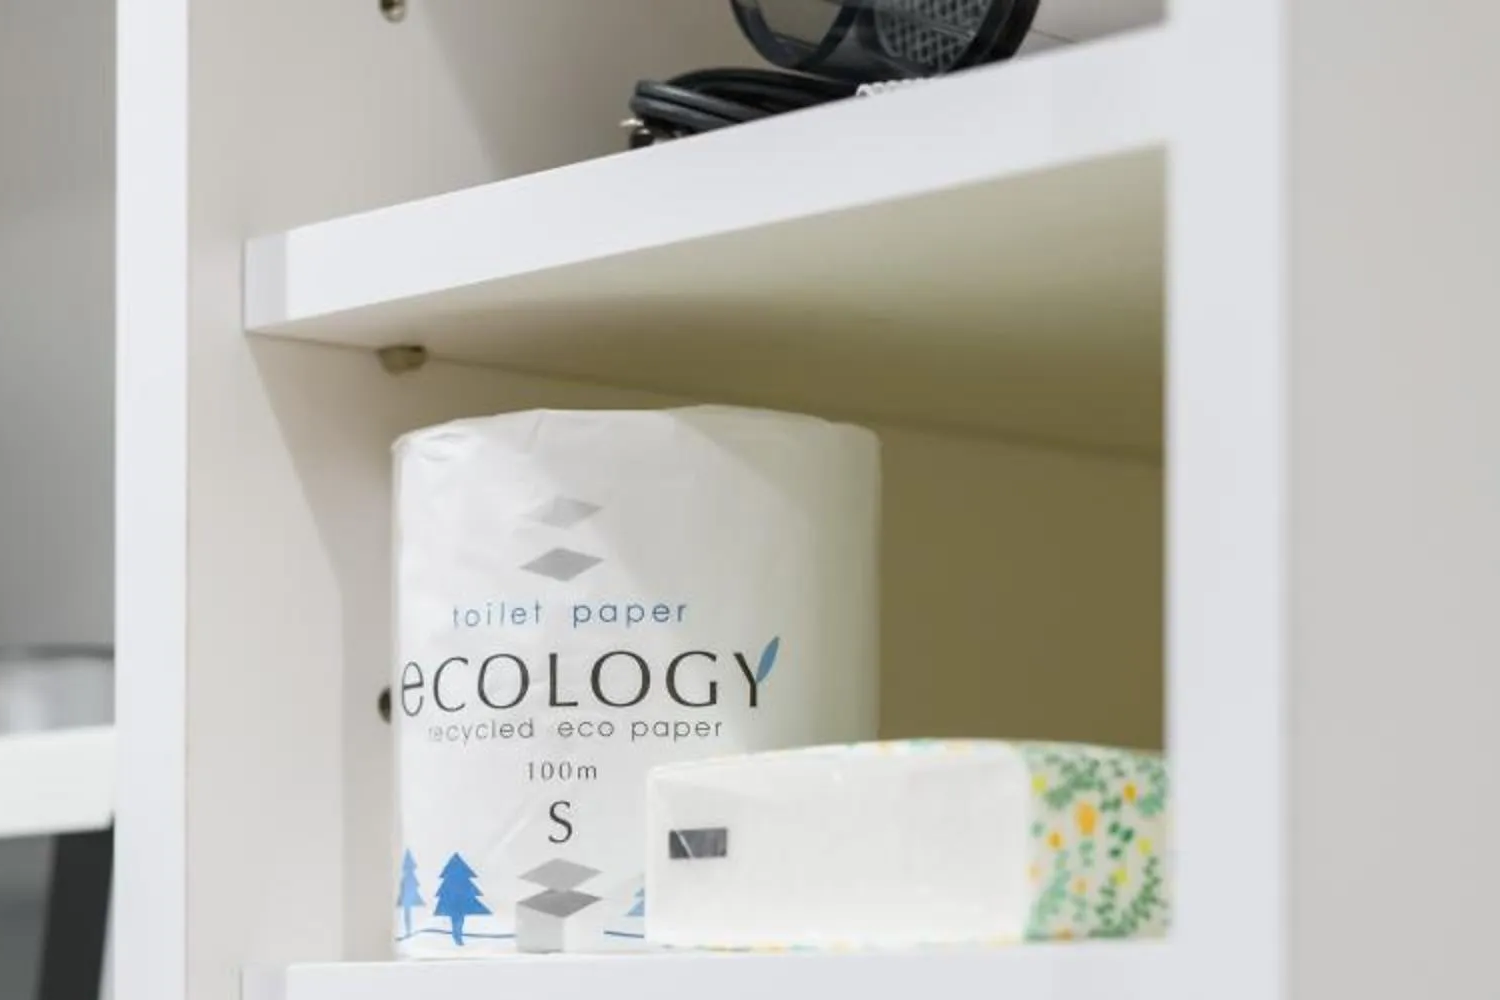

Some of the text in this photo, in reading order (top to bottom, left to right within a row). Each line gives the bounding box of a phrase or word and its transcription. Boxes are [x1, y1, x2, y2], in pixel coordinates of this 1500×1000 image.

[451, 600, 688, 629] toilet paper
[427, 718, 723, 747] recycled eco paper
[526, 760, 599, 782] 100m
[547, 801, 575, 843] S
